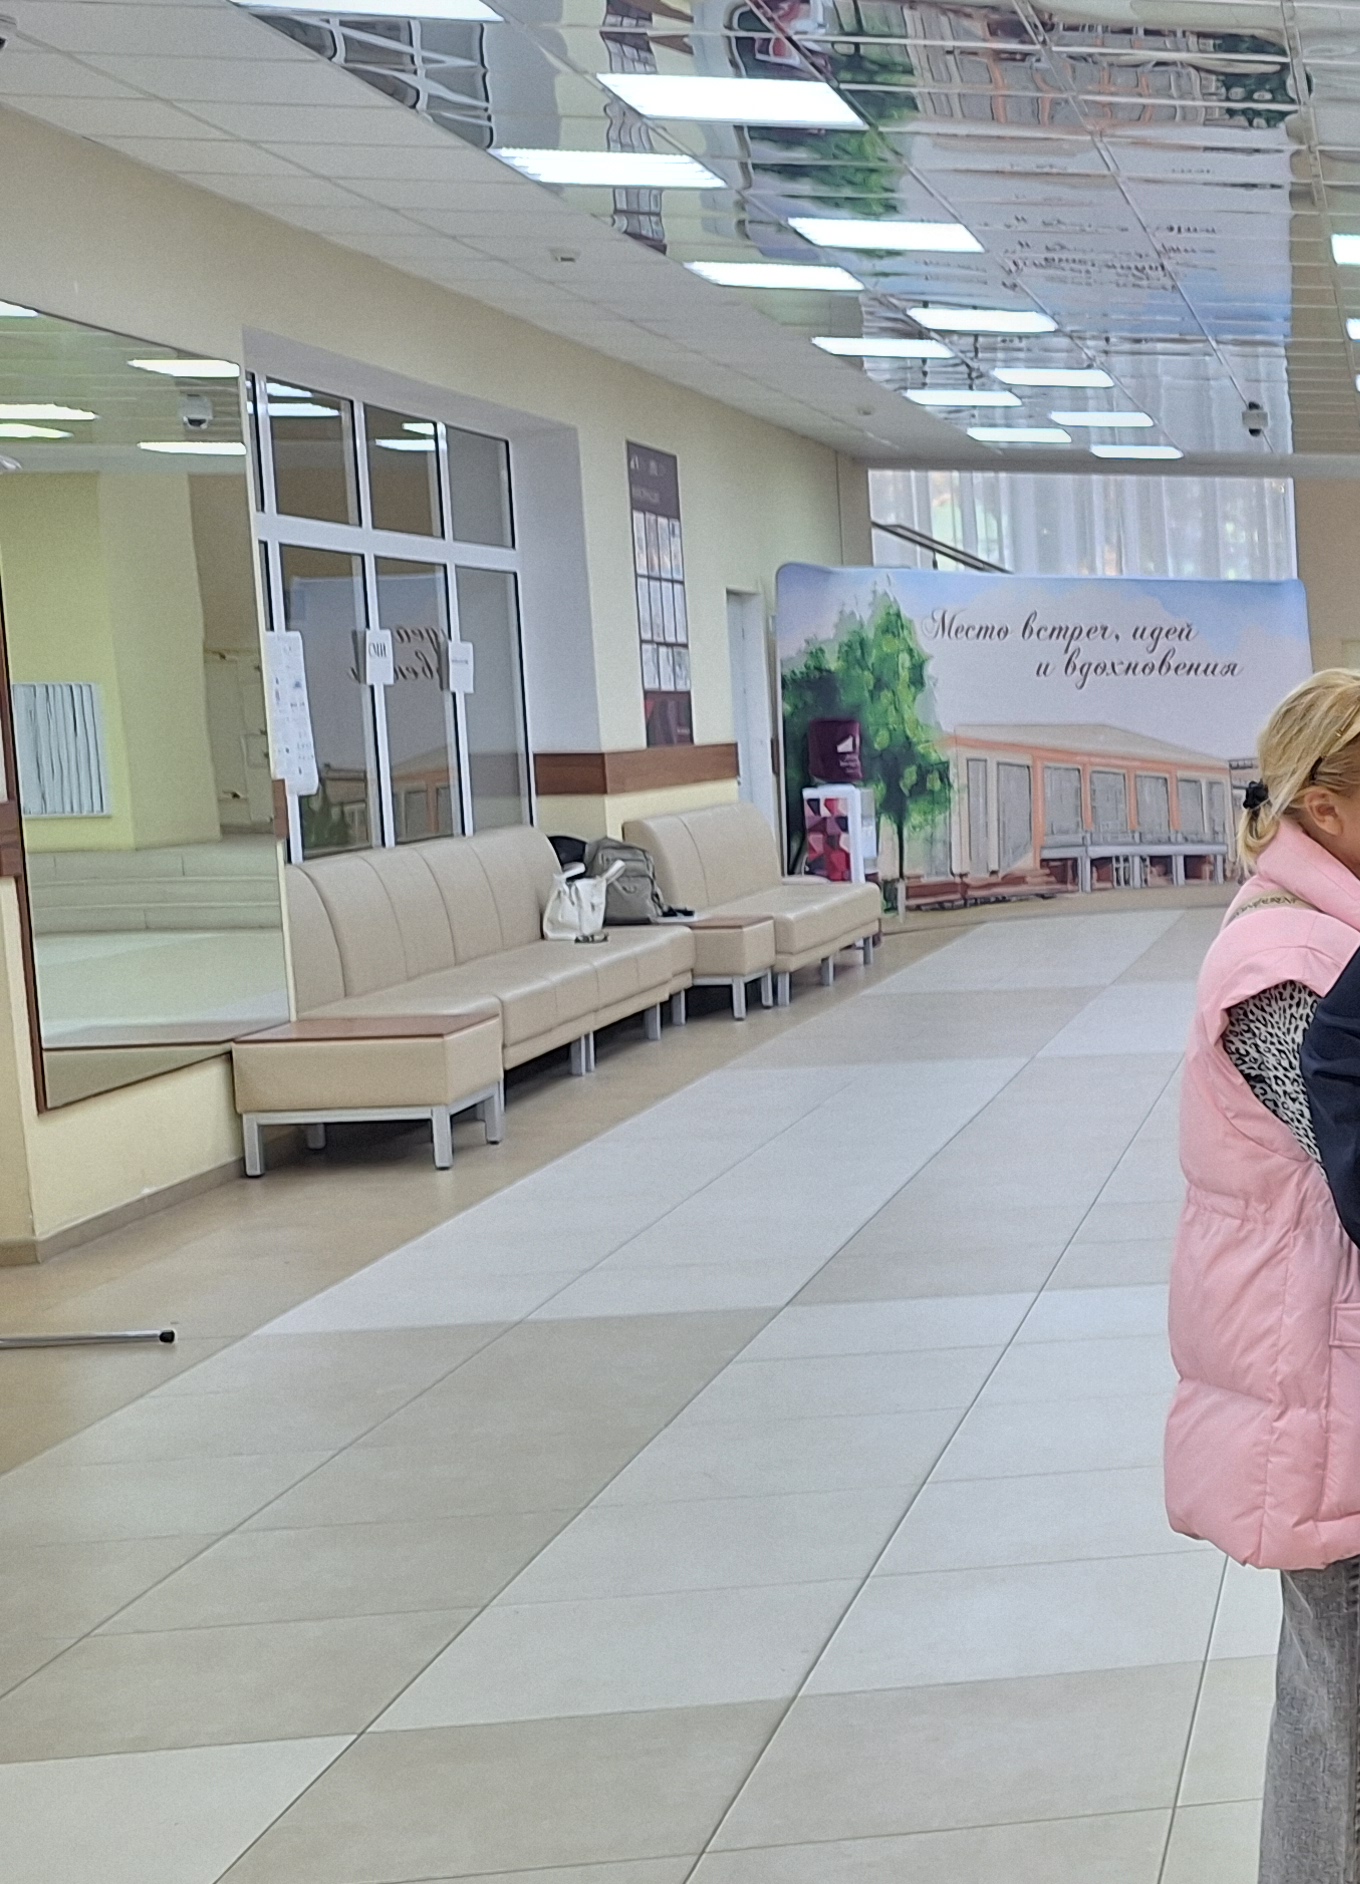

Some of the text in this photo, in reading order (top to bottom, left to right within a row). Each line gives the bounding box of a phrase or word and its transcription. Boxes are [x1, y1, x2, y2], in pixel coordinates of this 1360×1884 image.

[921, 609, 1199, 654] Место встреч, идей
[1035, 647, 1244, 690] и вдохновения
